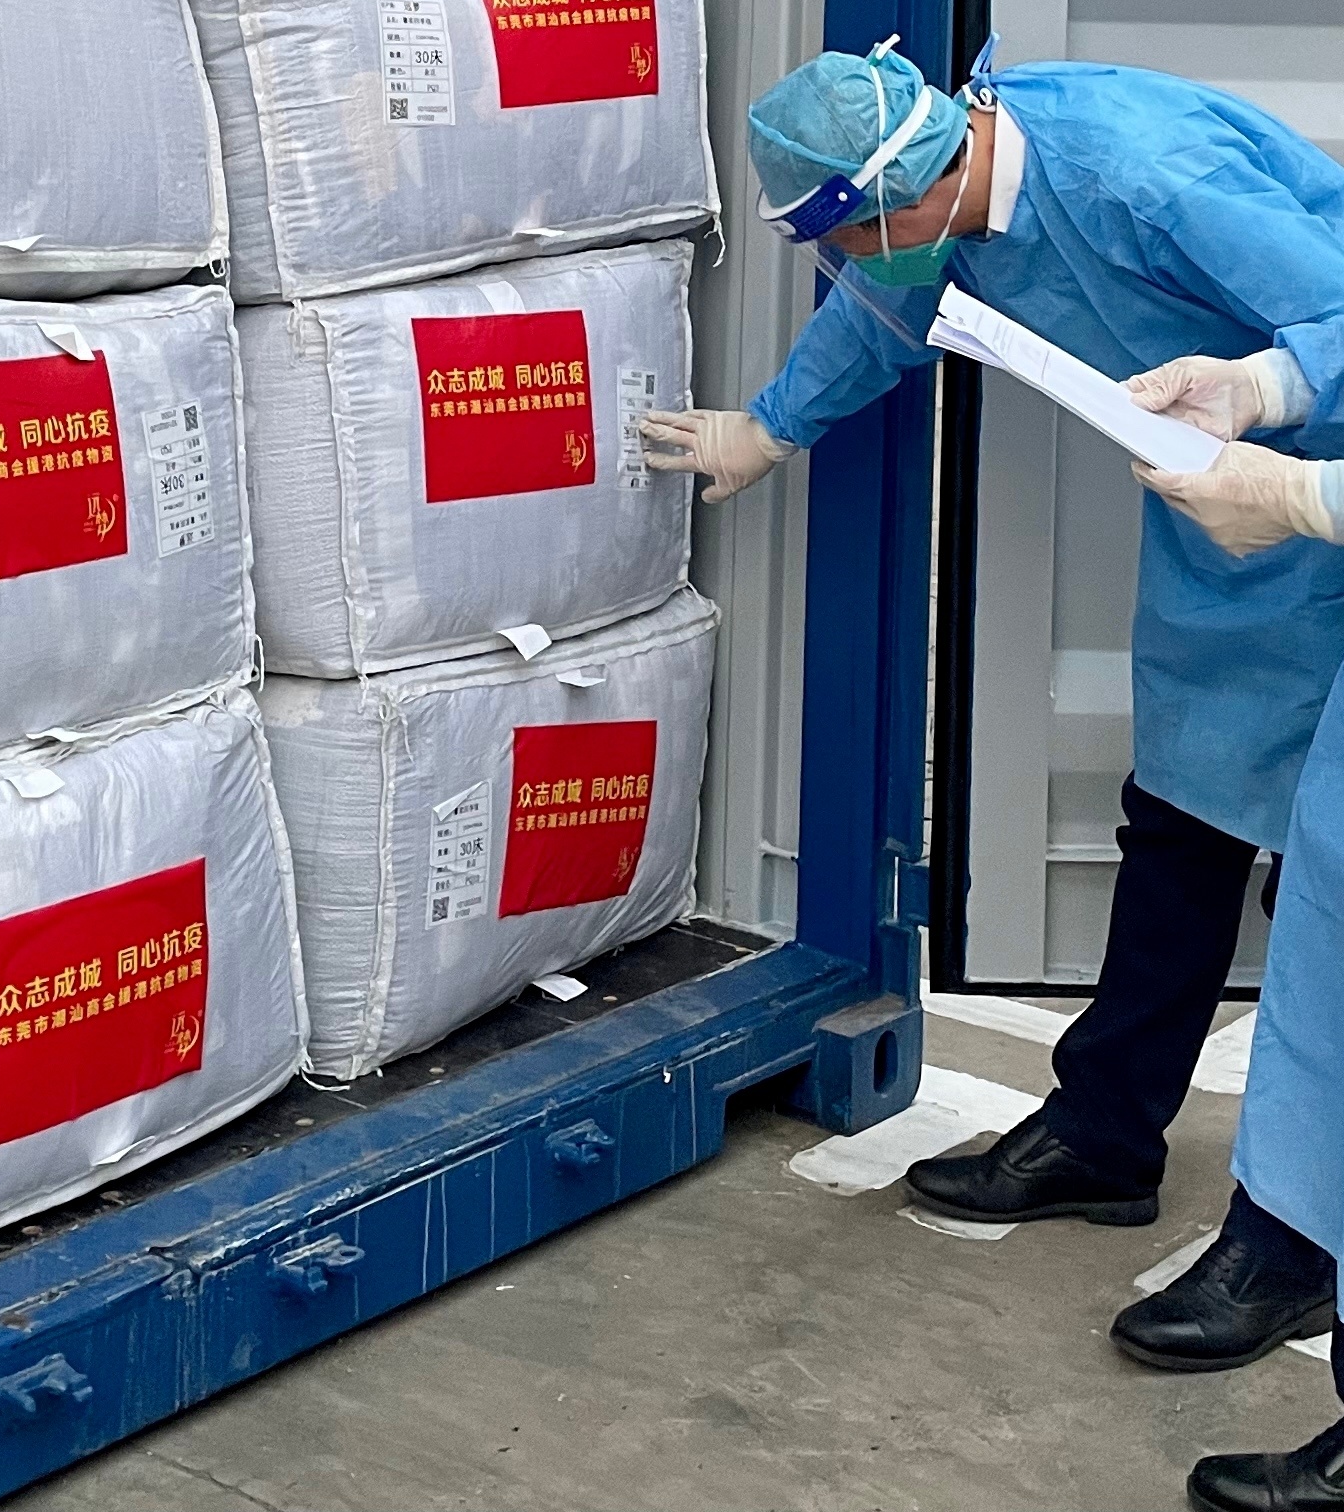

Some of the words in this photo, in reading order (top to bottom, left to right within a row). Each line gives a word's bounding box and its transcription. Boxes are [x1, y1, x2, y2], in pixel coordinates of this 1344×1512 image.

[415, 50, 443, 65] 30床
[427, 365, 505, 394] 众志成城
[515, 361, 584, 389] 同心抗疫
[20, 409, 112, 449] 同心抗疫
[517, 779, 583, 808] 众志成城
[591, 774, 649, 802] 同心抗疫
[117, 922, 204, 979] 同心抗疫
